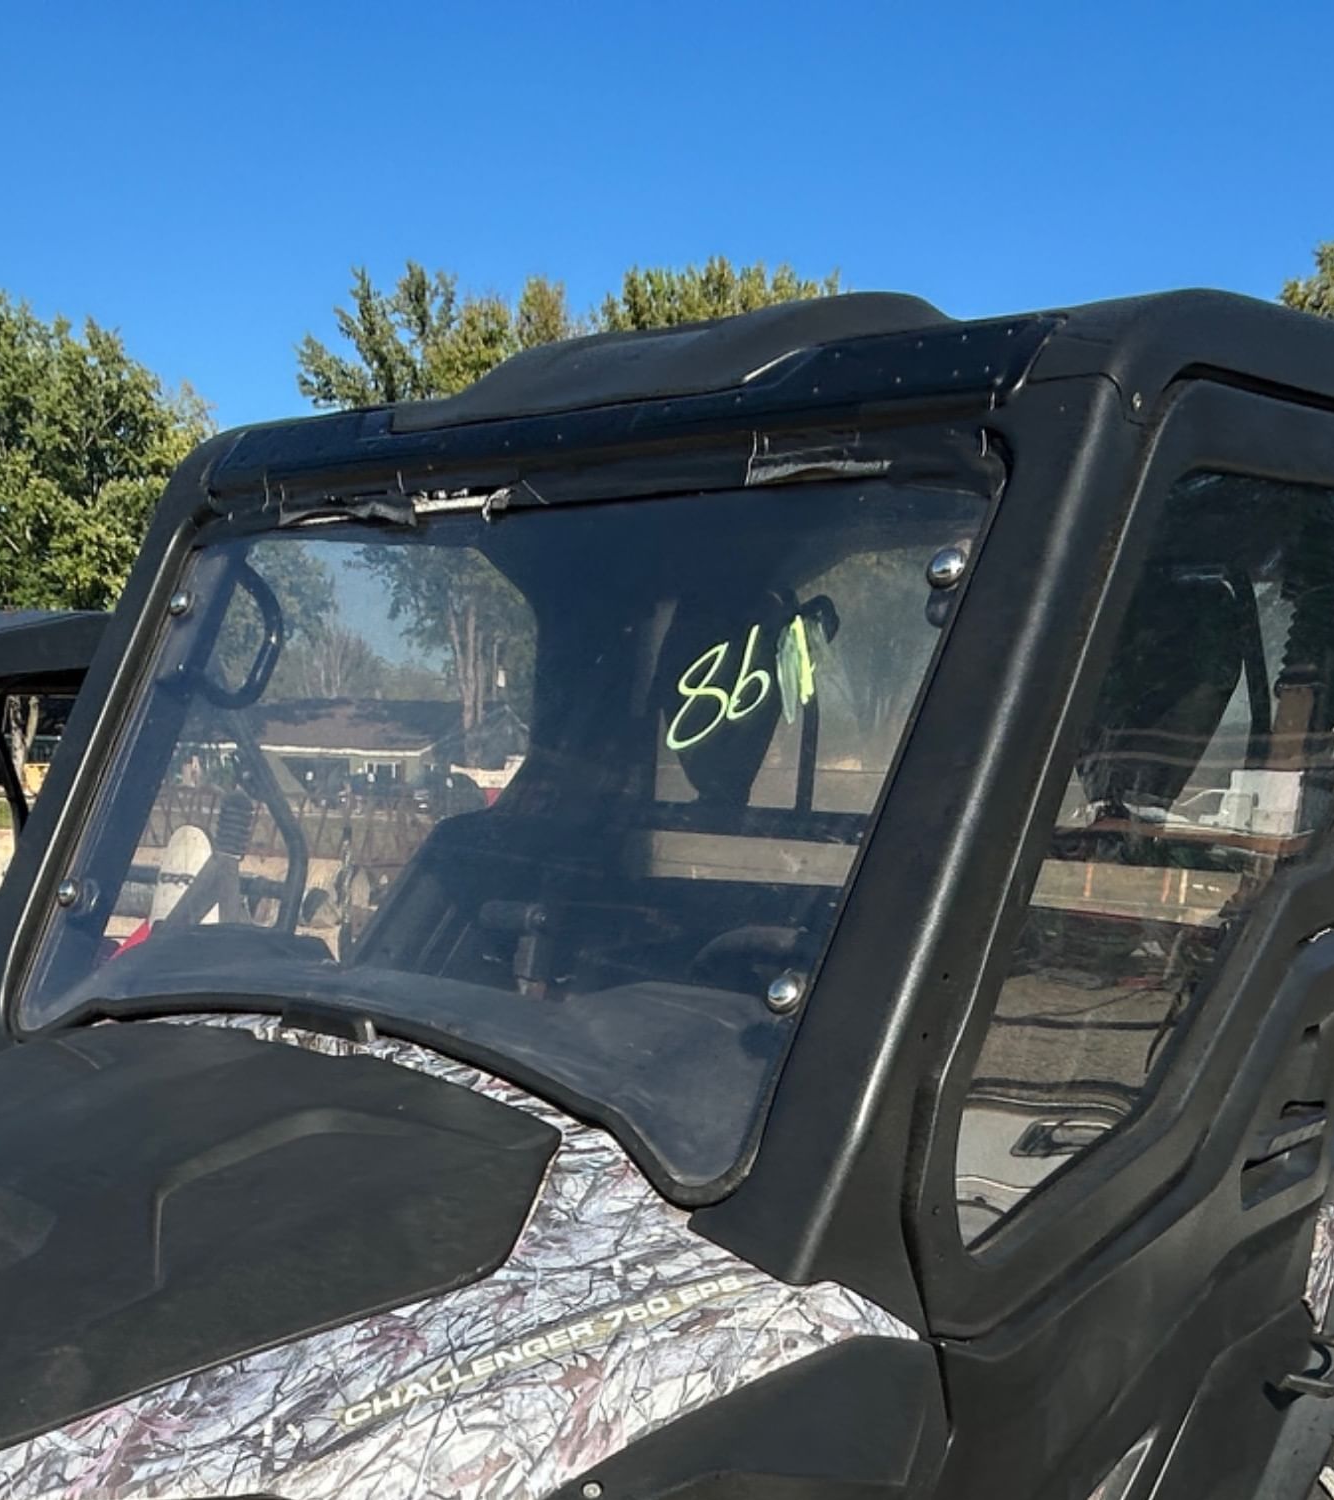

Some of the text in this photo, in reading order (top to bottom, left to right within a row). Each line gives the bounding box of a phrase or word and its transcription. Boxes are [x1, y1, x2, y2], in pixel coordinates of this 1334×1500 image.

[344, 1275, 744, 1427] CHALLENGER 750 EPS
